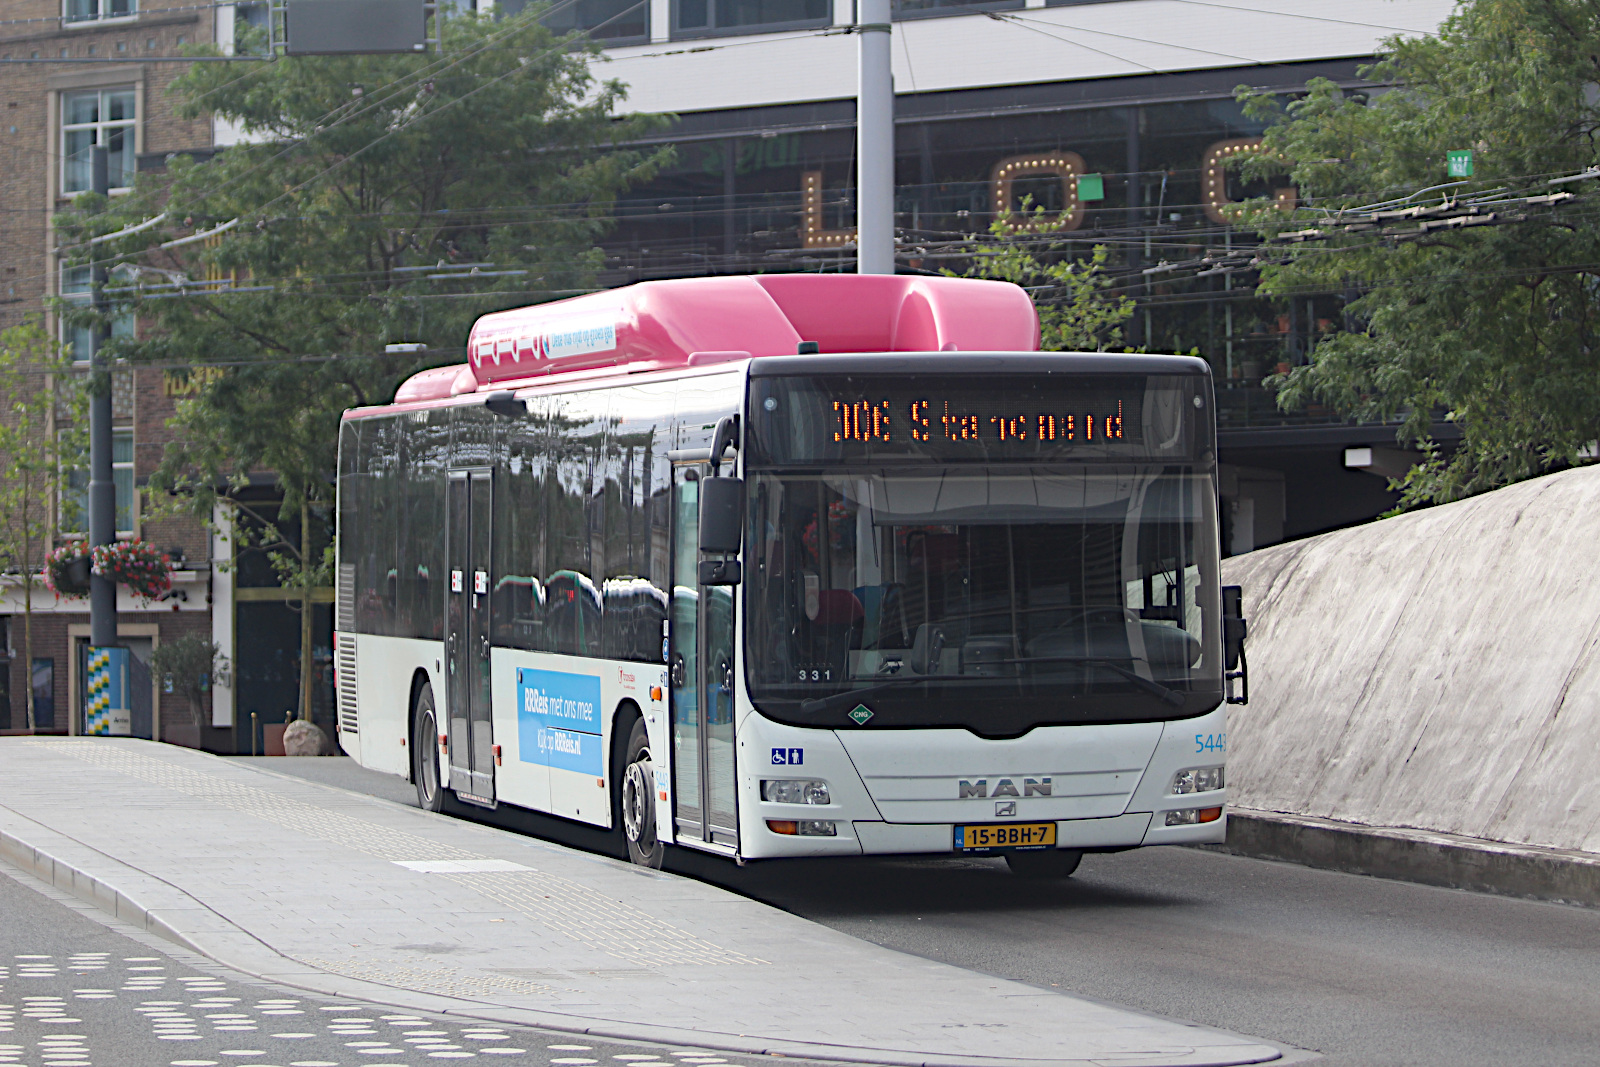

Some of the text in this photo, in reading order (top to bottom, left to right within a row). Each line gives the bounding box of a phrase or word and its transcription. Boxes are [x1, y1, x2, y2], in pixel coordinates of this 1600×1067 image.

[799, 670, 830, 681] 331
[524, 687, 593, 721] RRReis met ons mee
[554, 731, 582, 756] RRReis.nl
[958, 778, 1052, 798] MAN
[971, 827, 1048, 845] 15-BBH-7
